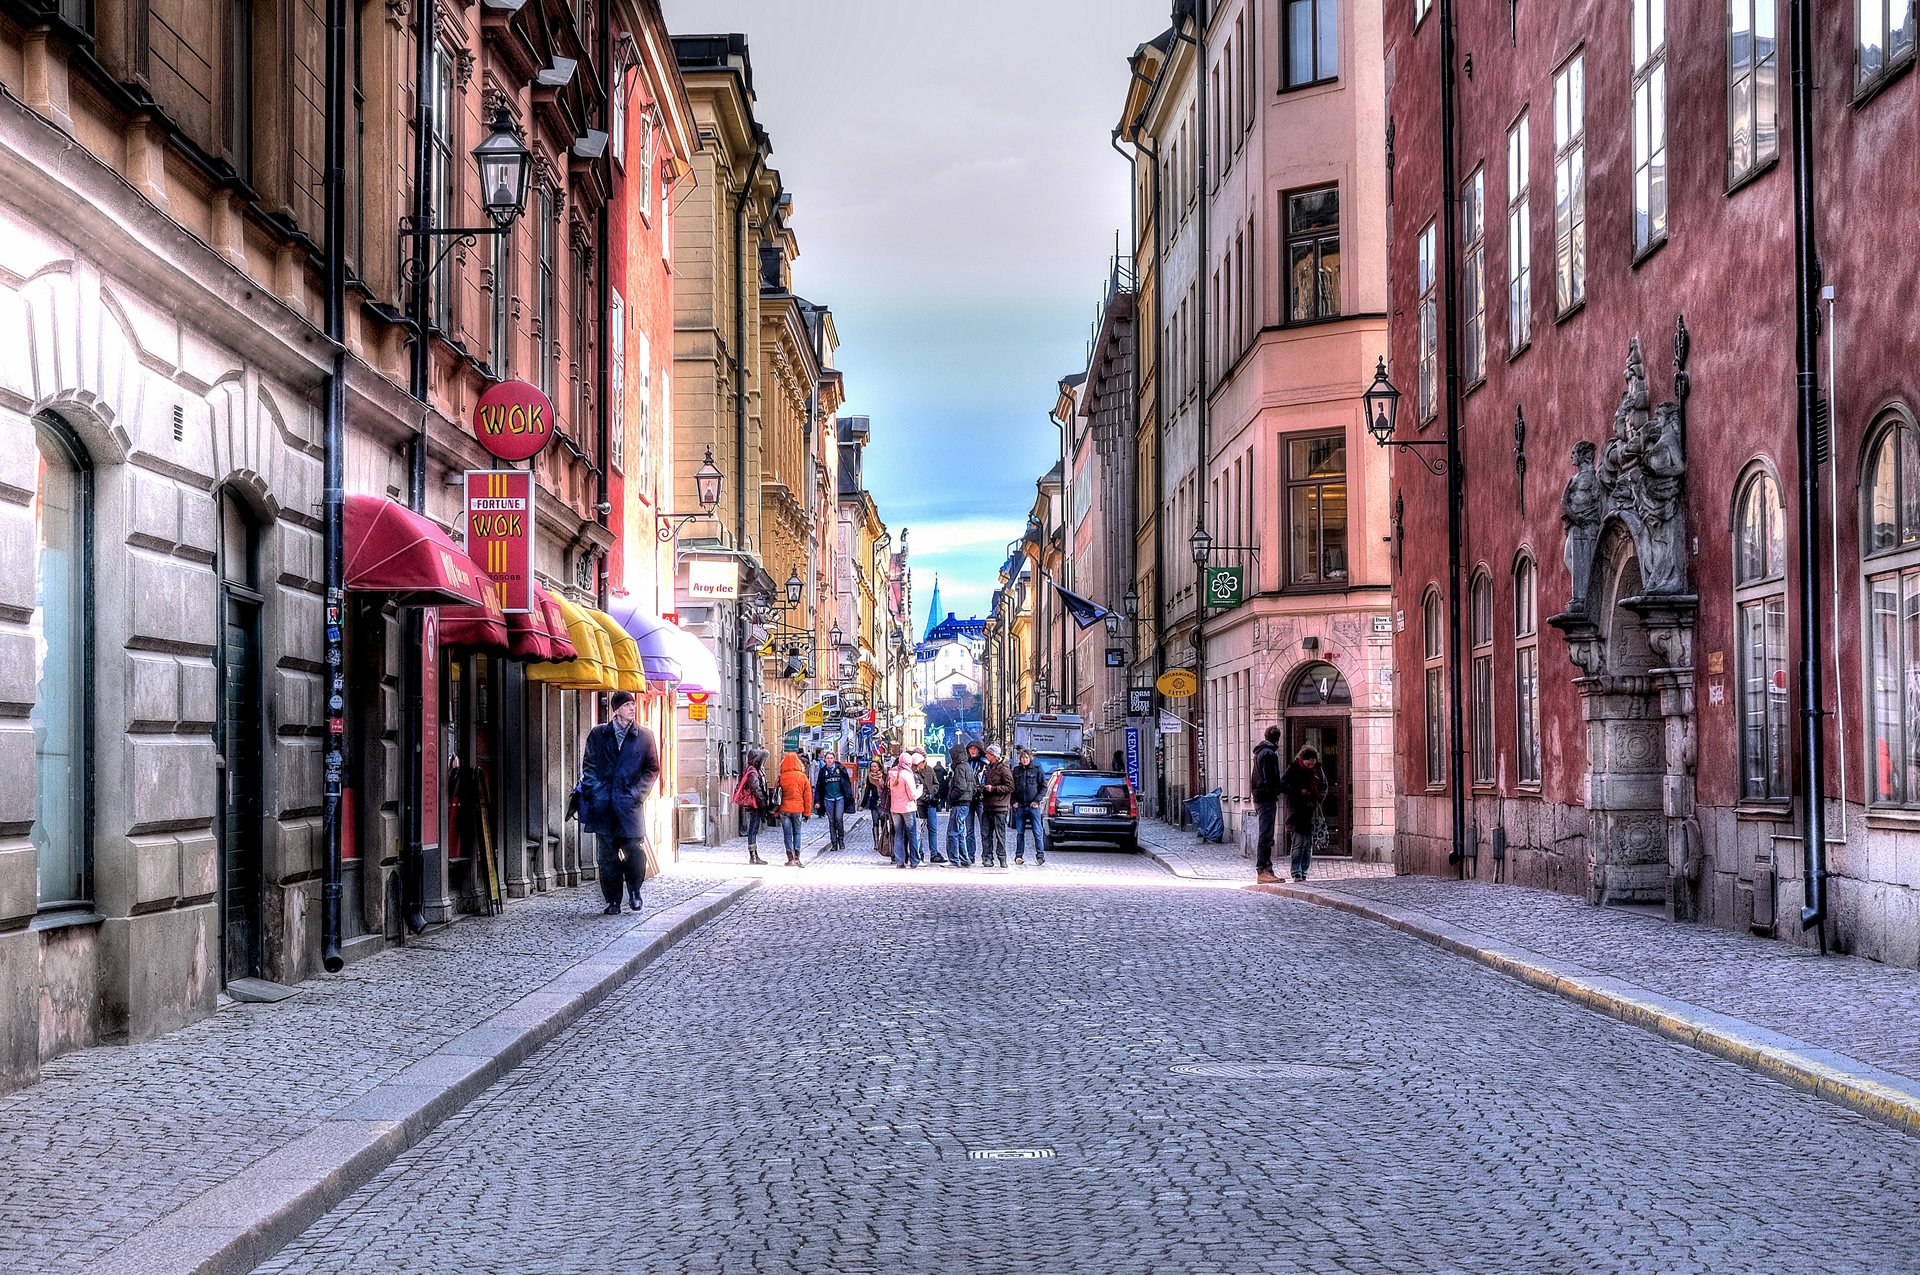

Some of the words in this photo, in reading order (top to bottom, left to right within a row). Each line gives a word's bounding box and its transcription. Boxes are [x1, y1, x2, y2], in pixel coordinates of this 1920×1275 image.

[480, 403, 544, 434] WOK
[477, 499, 520, 509] FORTUNE
[472, 513, 522, 537] WOK
[693, 583, 714, 593] Aroy
[1320, 677, 1328, 696] 4
[1127, 731, 1139, 787] KEMTVÄTT
